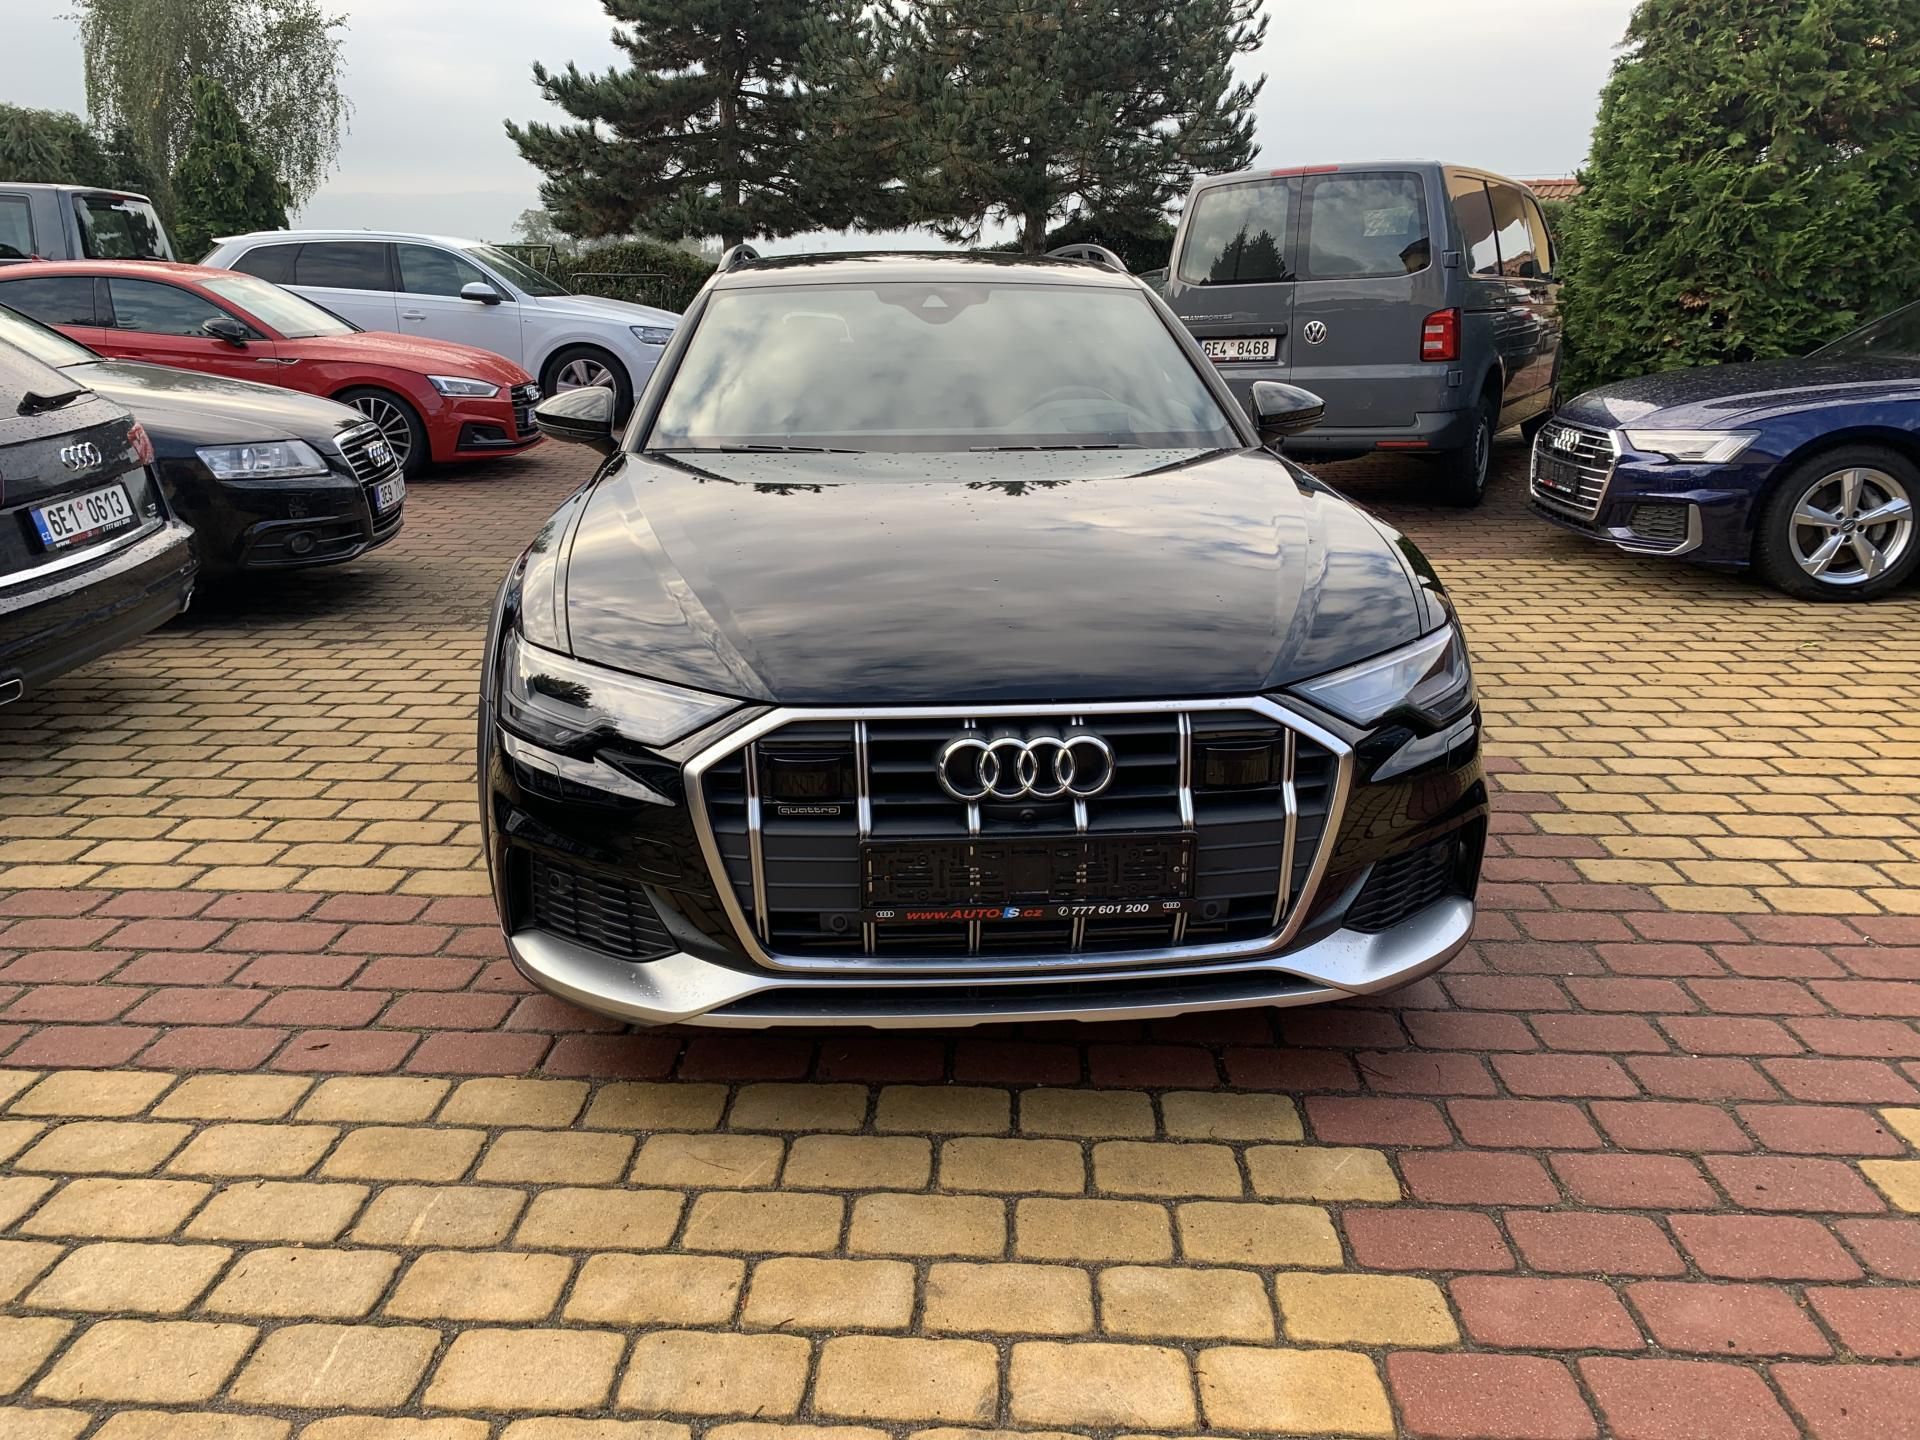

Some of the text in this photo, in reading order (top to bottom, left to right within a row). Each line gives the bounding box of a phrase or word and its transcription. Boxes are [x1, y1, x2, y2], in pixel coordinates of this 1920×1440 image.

[1204, 341, 1270, 356] 6E4 8468
[48, 490, 124, 536] 6E1 0613
[1072, 906, 1095, 915] 777
[1098, 905, 1122, 914] 601
[1125, 904, 1149, 913] 200
